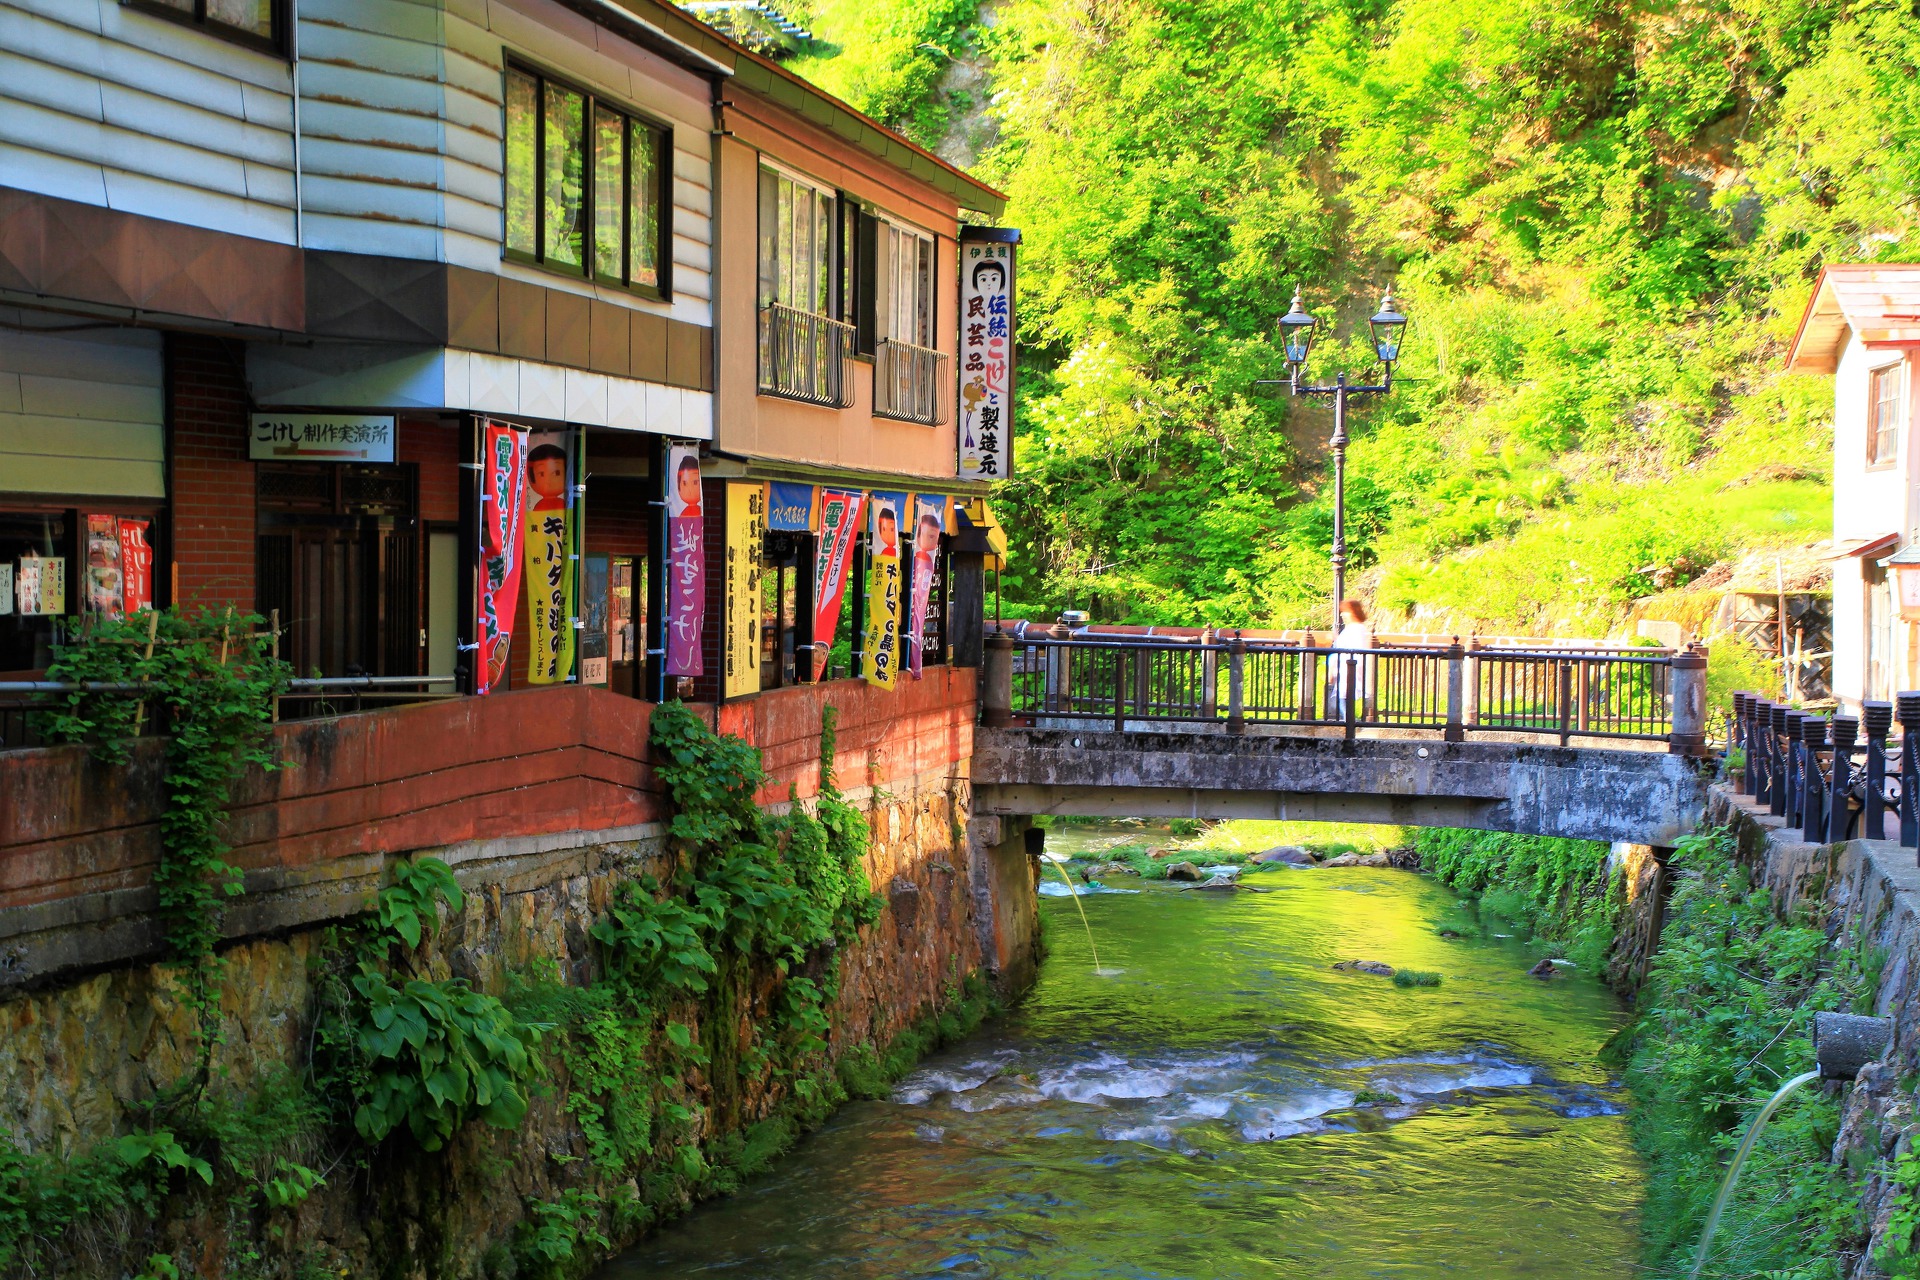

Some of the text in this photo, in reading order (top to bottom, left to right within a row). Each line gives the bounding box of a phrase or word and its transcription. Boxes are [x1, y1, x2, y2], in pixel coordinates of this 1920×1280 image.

[965, 295, 986, 372] 民芸品
[257, 422, 389, 444] こけし制作実演所
